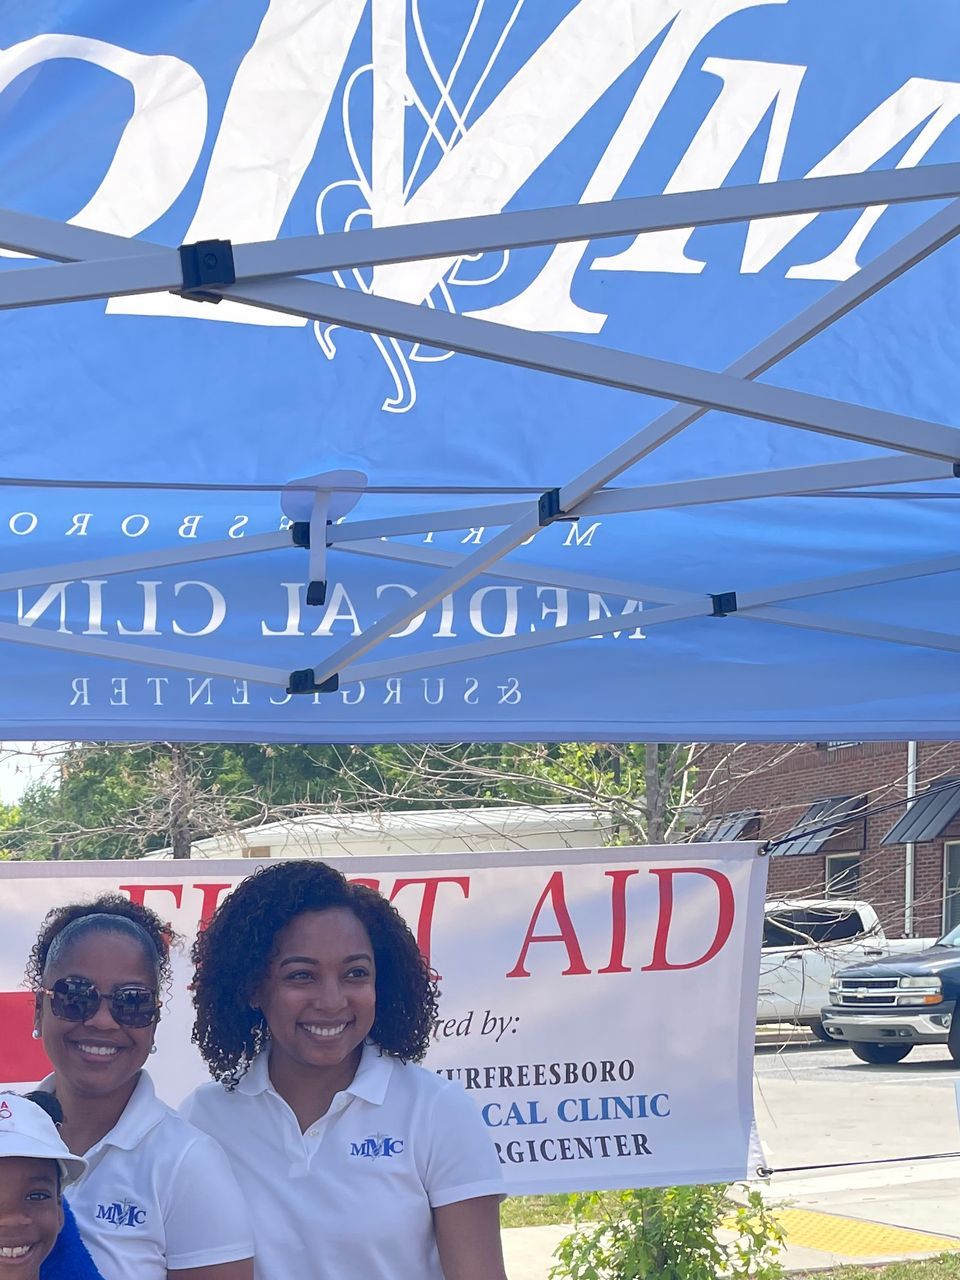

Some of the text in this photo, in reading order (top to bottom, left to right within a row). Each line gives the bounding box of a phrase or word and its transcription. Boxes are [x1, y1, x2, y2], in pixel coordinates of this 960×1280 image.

[506, 867, 735, 978] AID
[431, 1010, 520, 1043] red by:
[436, 1058, 635, 1090] URFREESBORO
[481, 1093, 671, 1127] CAL CLINIC
